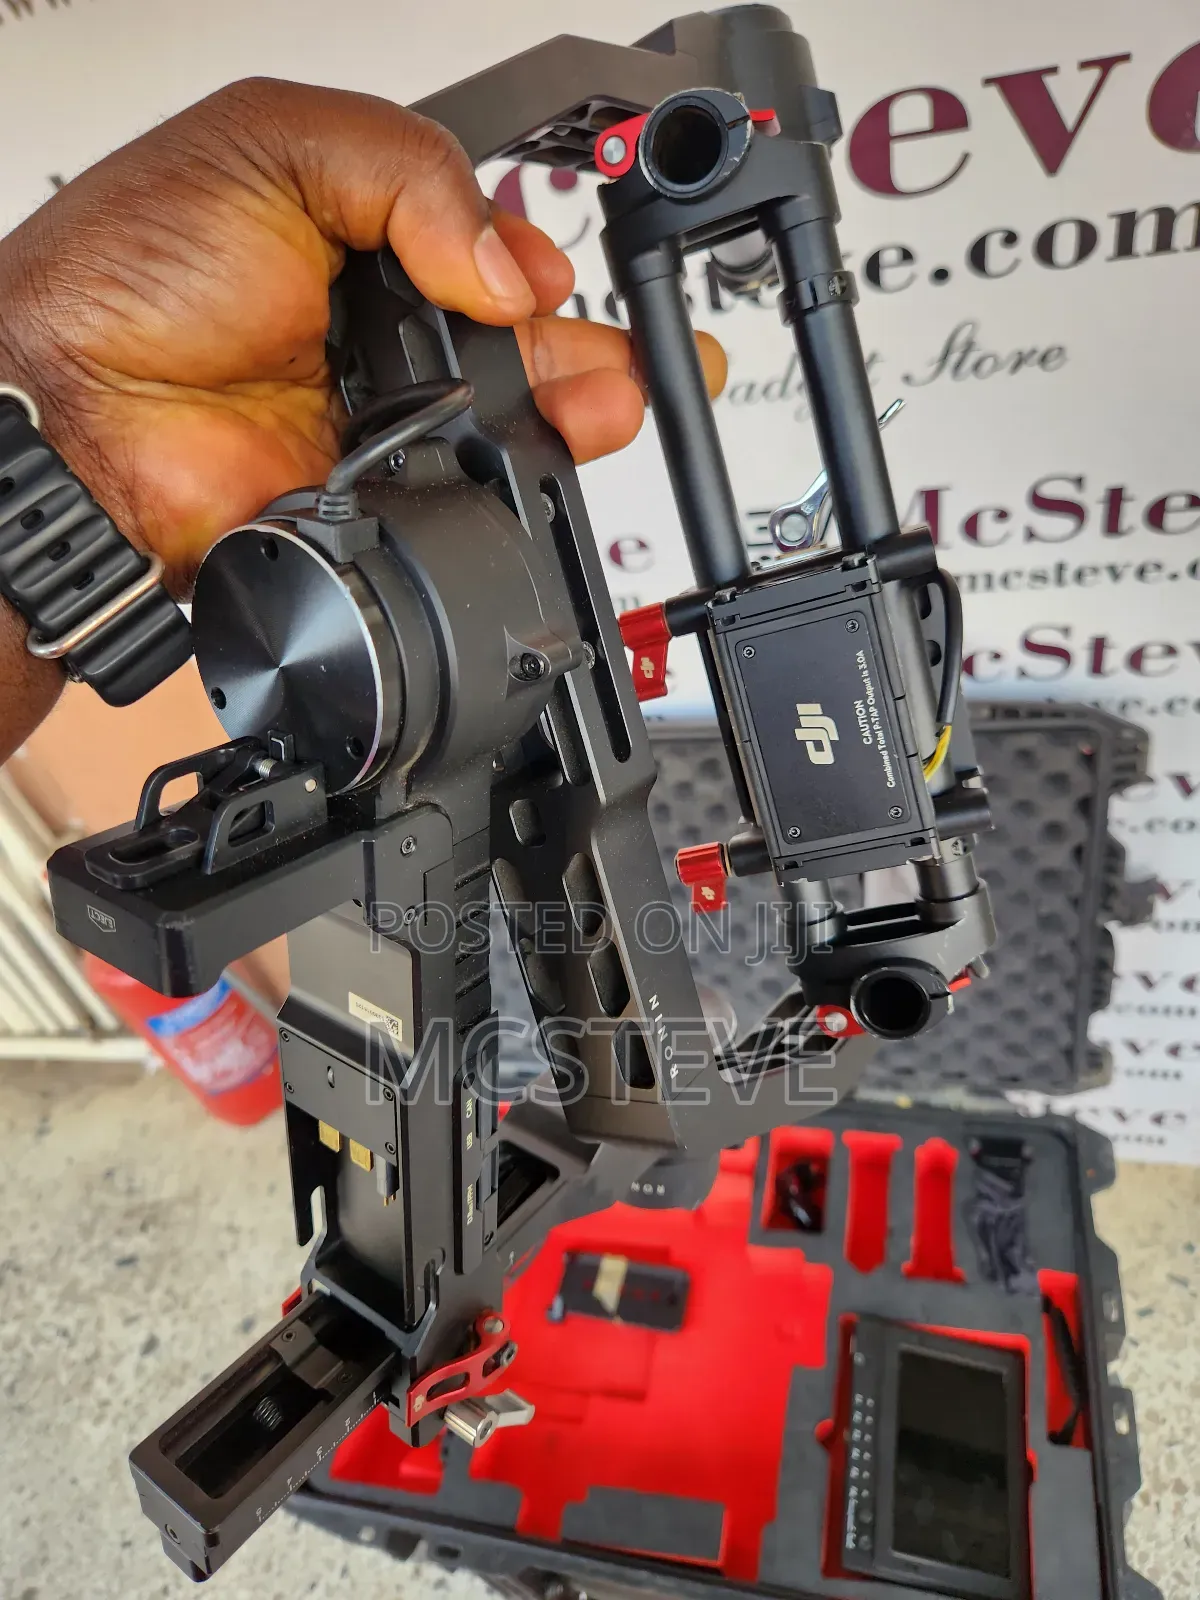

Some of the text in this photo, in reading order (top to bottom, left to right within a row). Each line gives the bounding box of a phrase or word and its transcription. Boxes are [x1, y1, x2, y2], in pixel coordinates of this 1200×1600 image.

[901, 319, 1070, 388] Store
[862, 678, 876, 705] Output
[853, 699, 873, 745] CAUTION
[875, 731, 888, 751] Total
[880, 751, 896, 788] Combined
[648, 994, 680, 1080] RONIN
